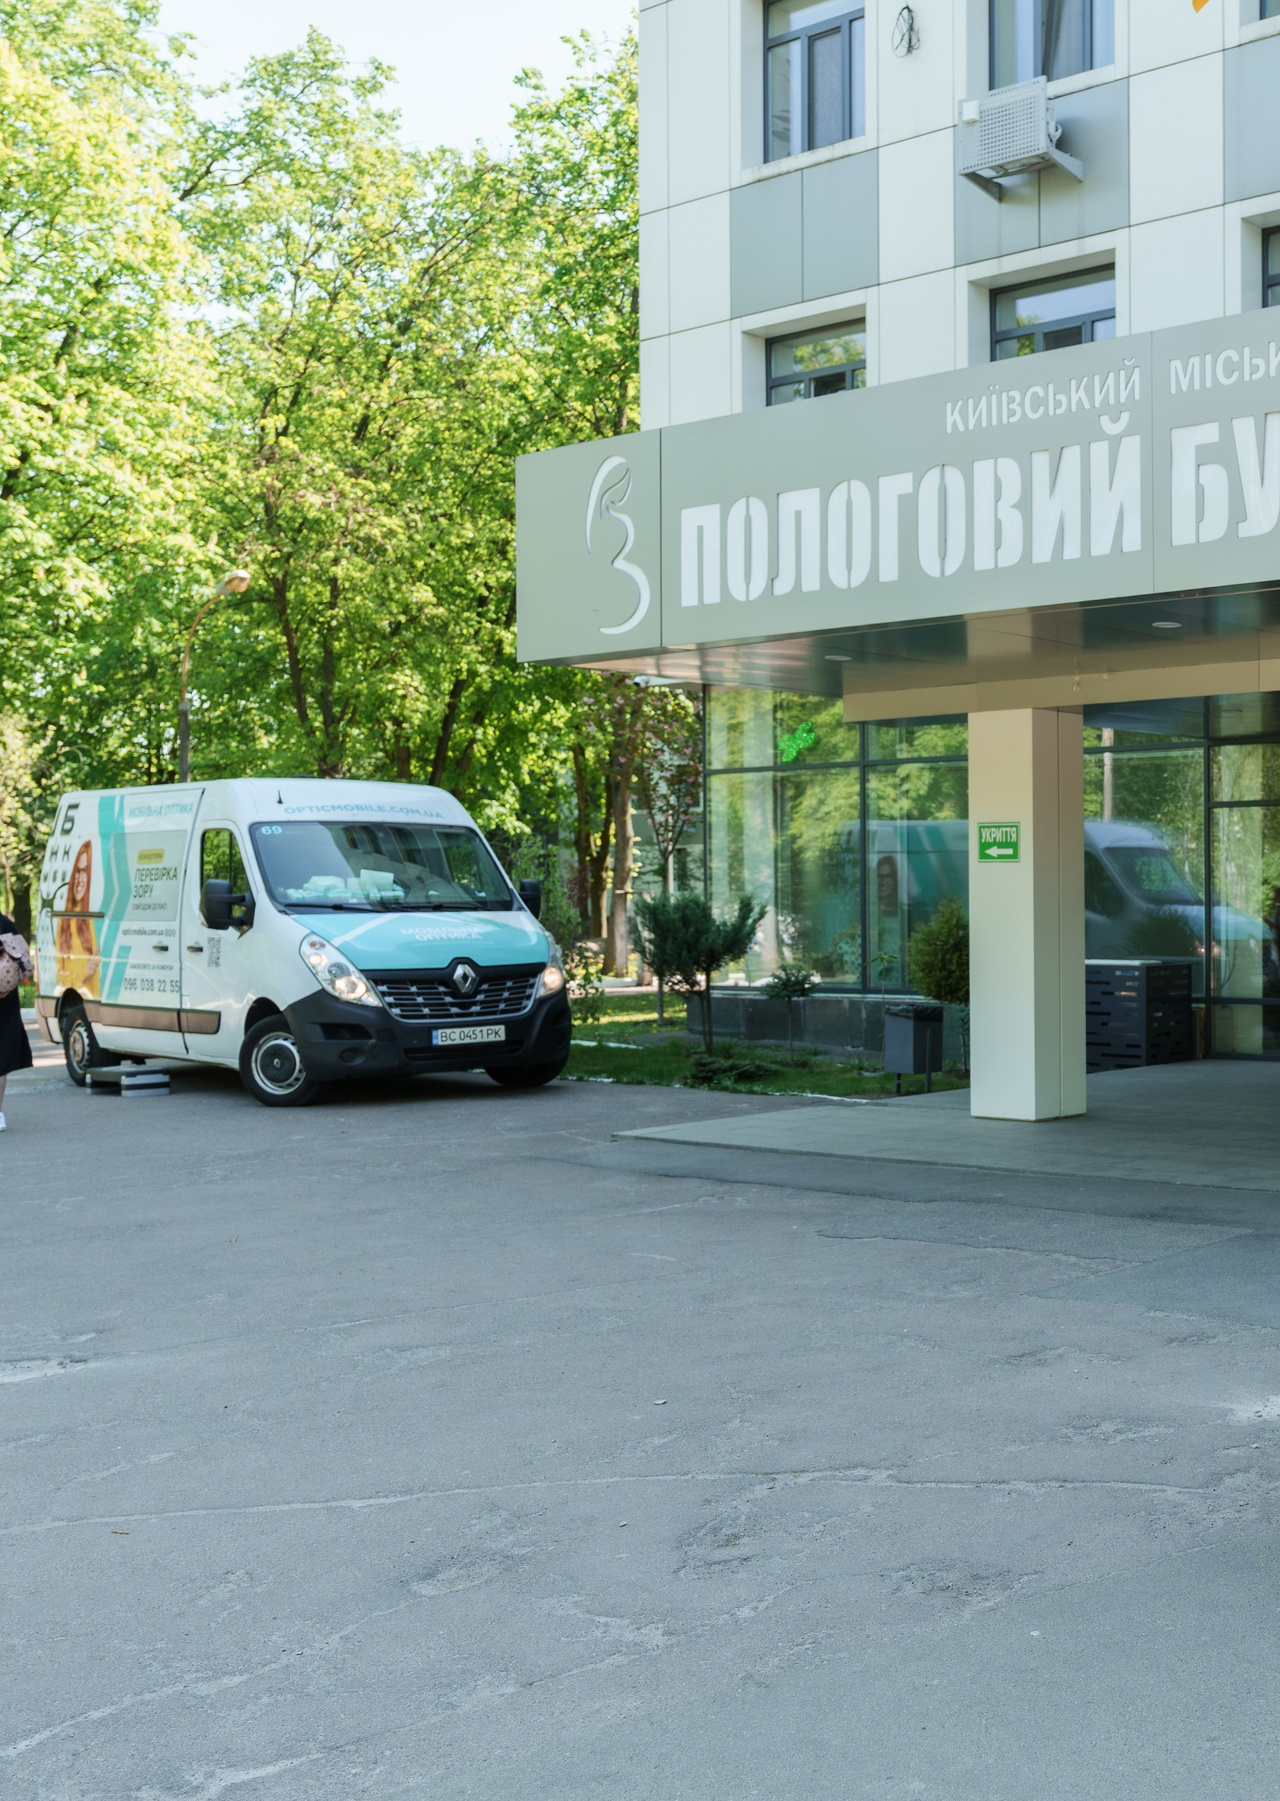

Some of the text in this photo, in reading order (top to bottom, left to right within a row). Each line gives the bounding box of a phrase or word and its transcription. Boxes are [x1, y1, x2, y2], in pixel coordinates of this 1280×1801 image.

[945, 356, 1141, 435] КИЇВСЬКИЙ
[680, 410, 1143, 608] ПОЛОГОВИЙ
[128, 802, 193, 818] МОБІЛЬНА ОПТИКА
[284, 804, 445, 820] OPTICMOBILE.COM.UA
[261, 825, 283, 836] 69
[981, 827, 1017, 843] УКРИТТЯ
[134, 867, 178, 883] ПЕРЕВІРКА
[133, 884, 154, 898] ЗОРУ
[122, 927, 164, 937] opticmobile.com.ua
[415, 932, 483, 941] ОПТИКА
[123, 978, 180, 993] 096 038 22 55
[459, 1029, 484, 1041] 0451
